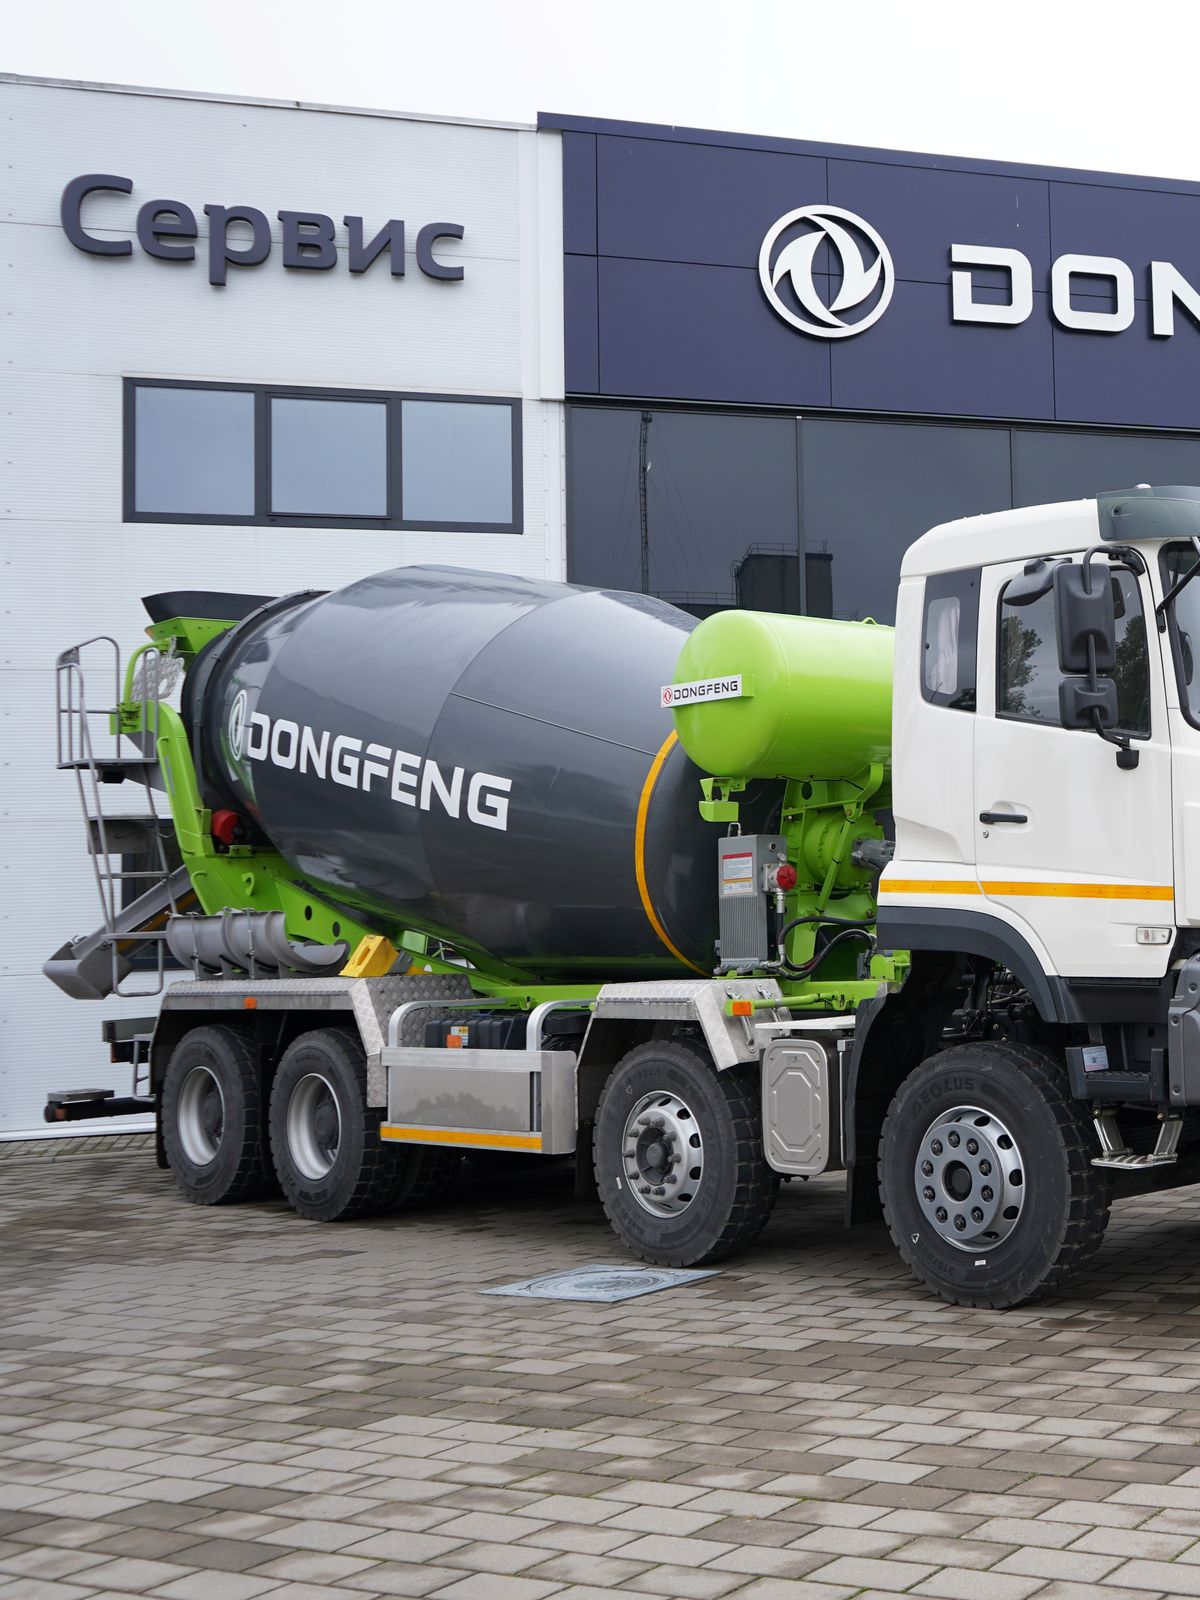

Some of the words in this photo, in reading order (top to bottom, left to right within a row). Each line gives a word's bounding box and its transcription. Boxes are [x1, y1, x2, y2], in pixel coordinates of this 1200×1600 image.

[60, 173, 465, 286] Сервис
[673, 680, 738, 700] DONGFENG
[247, 711, 513, 831] DONGFENG
[912, 1076, 976, 1120] AEOLUS
